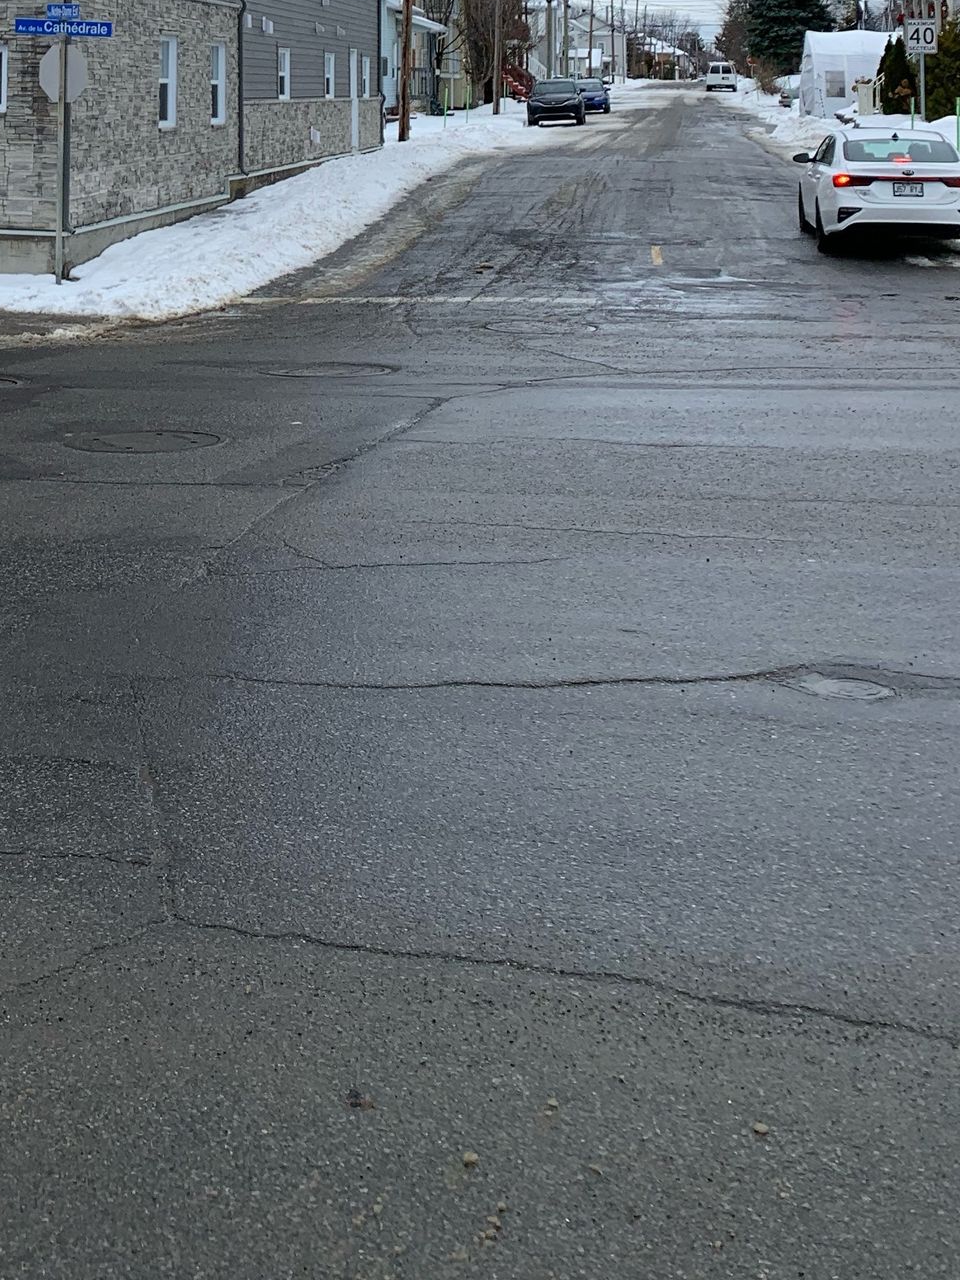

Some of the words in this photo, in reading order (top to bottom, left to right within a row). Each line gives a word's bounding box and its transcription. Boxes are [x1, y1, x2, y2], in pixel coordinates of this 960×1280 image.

[17, 24, 27, 32] Av.
[43, 21, 108, 35] Cathédrale
[909, 27, 934, 44] 40
